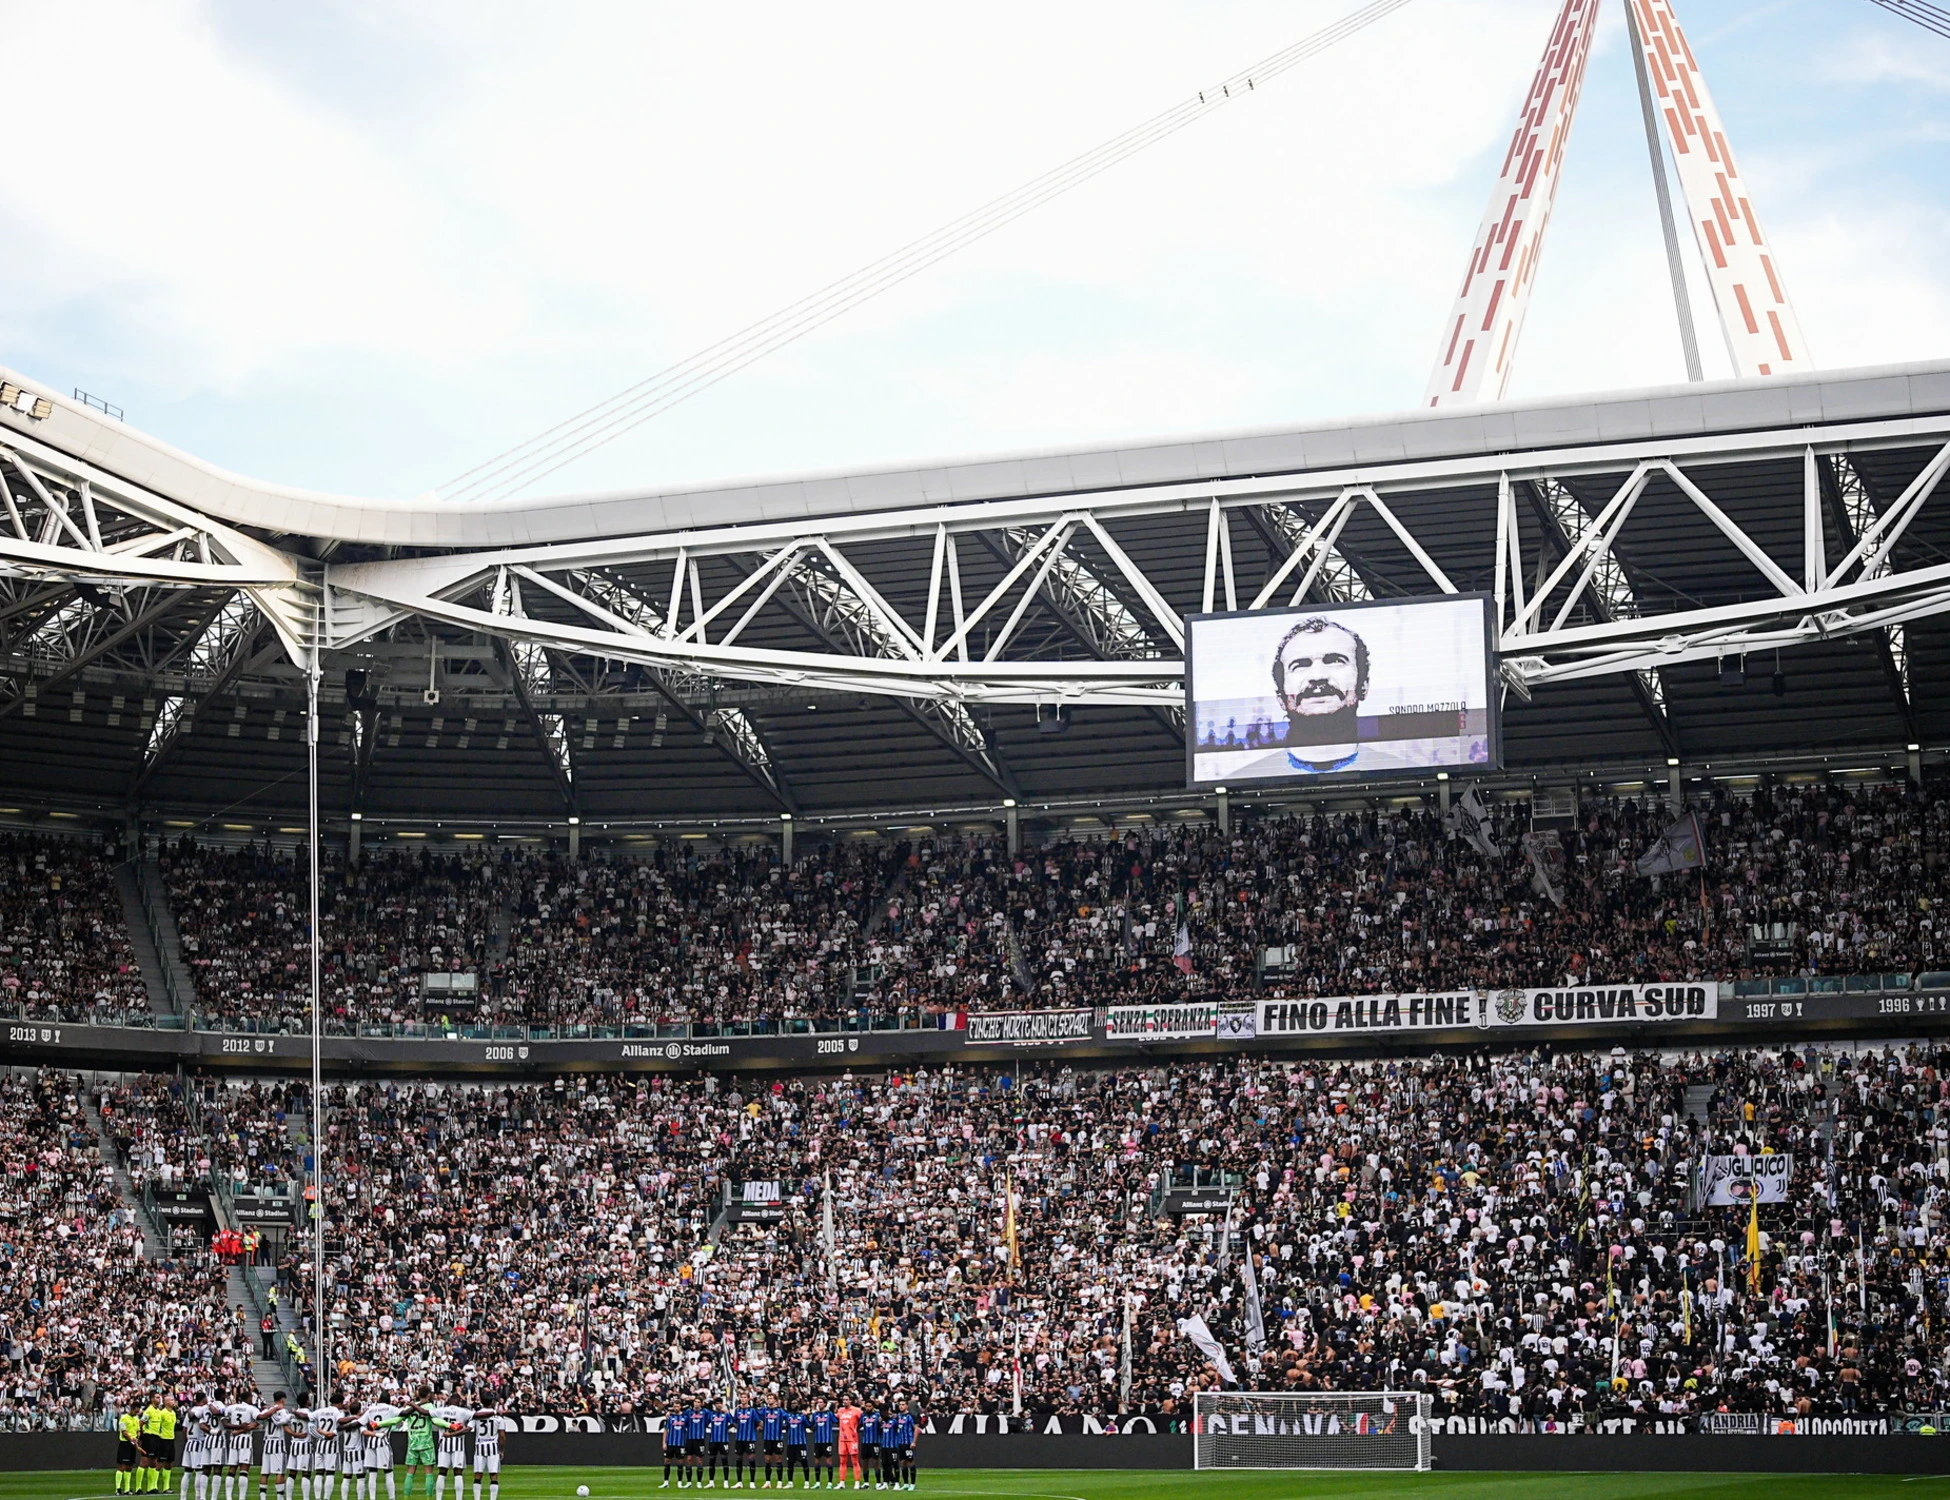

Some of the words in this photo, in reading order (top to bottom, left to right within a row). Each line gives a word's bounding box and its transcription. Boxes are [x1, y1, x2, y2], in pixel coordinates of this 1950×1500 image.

[1533, 989, 1637, 1021] CURVA
[1644, 987, 1706, 1017] SUD
[1746, 1003, 1776, 1018] 1997
[1878, 998, 1910, 1013] 1996
[1112, 1010, 1147, 1033] SENZA
[1152, 1007, 1212, 1032] SPERANZA
[1263, 1003, 1328, 1031] FINO
[1334, 1000, 1401, 1029] ALLA
[1409, 996, 1471, 1026] FINE
[10, 1027, 37, 1041] 2013
[222, 1039, 250, 1052] 2012
[485, 1046, 514, 1059] 2006
[621, 1045, 664, 1057] Allianz
[683, 1043, 730, 1056] Stadium
[817, 1040, 844, 1053] 2005
[743, 1180, 780, 1201] MEDA
[181, 1206, 204, 1214] Stadium
[265, 1208, 289, 1216] Stadium
[205, 1411, 219, 1428] 26
[319, 1418, 334, 1433] 22
[1714, 1414, 1758, 1428] ANDRIA
[479, 1419, 494, 1436] 31
